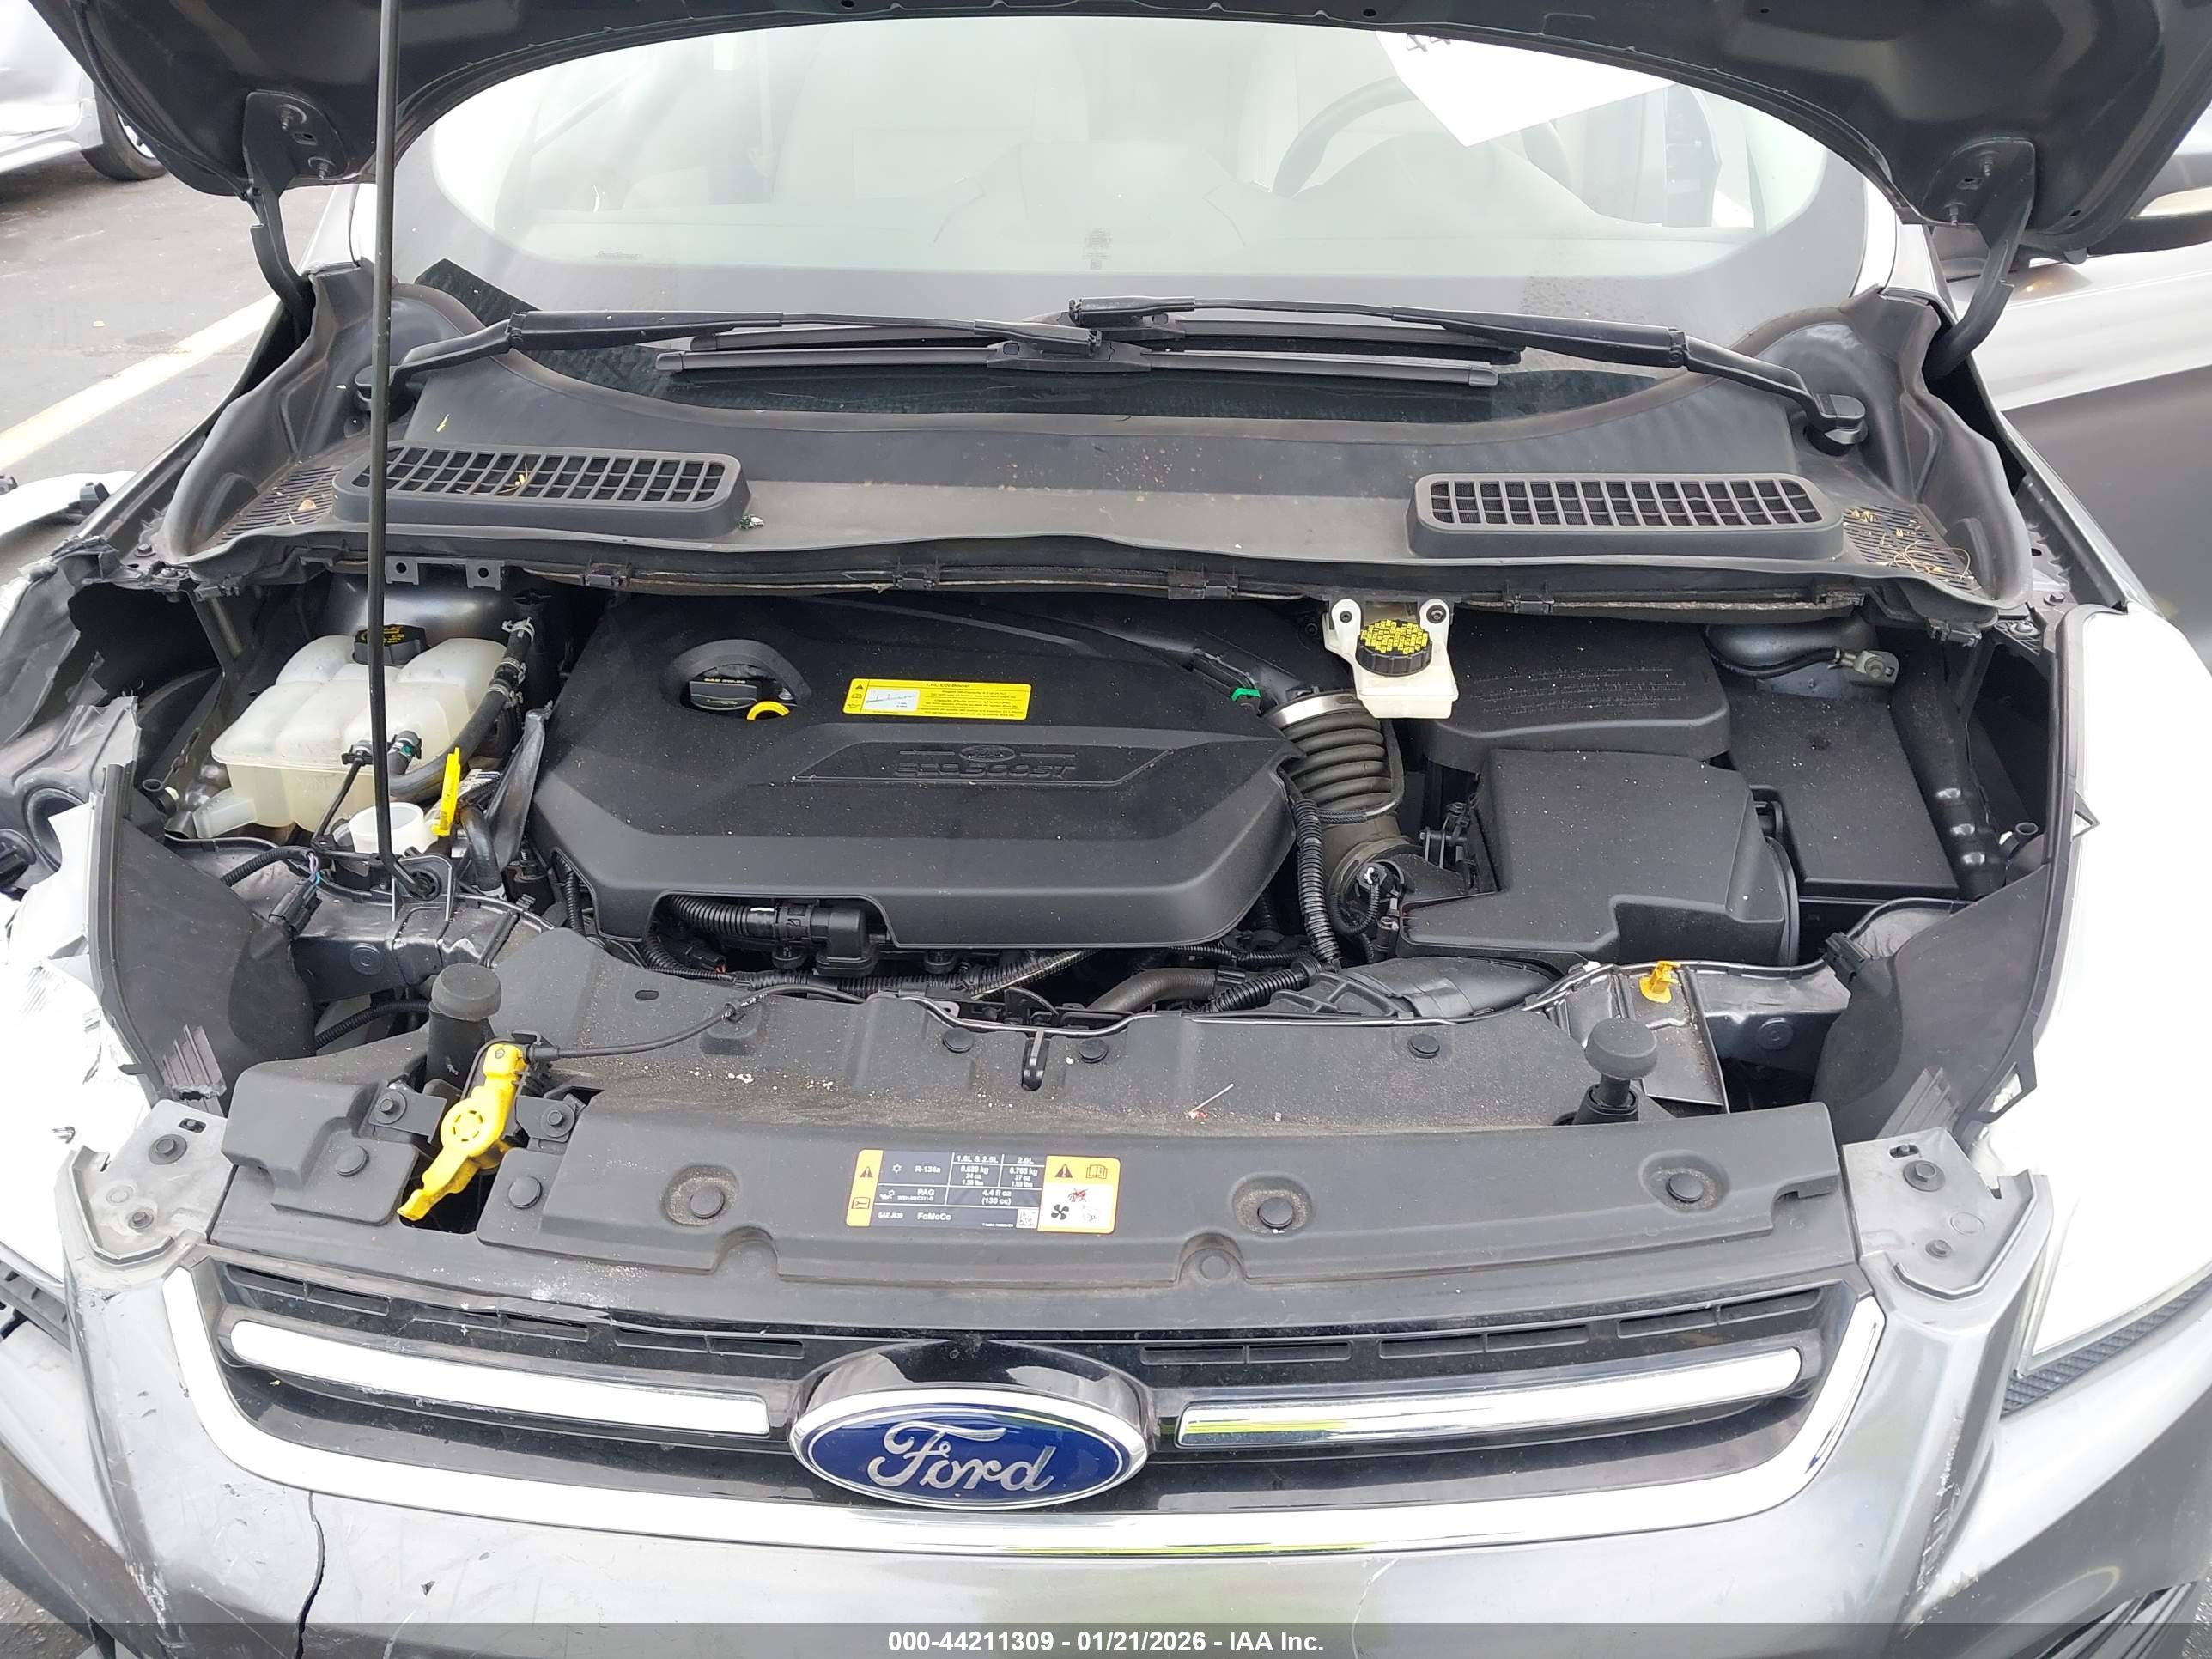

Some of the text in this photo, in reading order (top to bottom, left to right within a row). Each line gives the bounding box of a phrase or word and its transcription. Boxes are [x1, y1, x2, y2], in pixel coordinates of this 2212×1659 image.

[980, 1166, 989, 1175] kg
[1029, 1168, 1038, 1176] kg
[999, 1197, 1012, 1206] cc)
[917, 1212, 952, 1221] FoMoCo
[867, 1420, 1055, 1492] Ford
